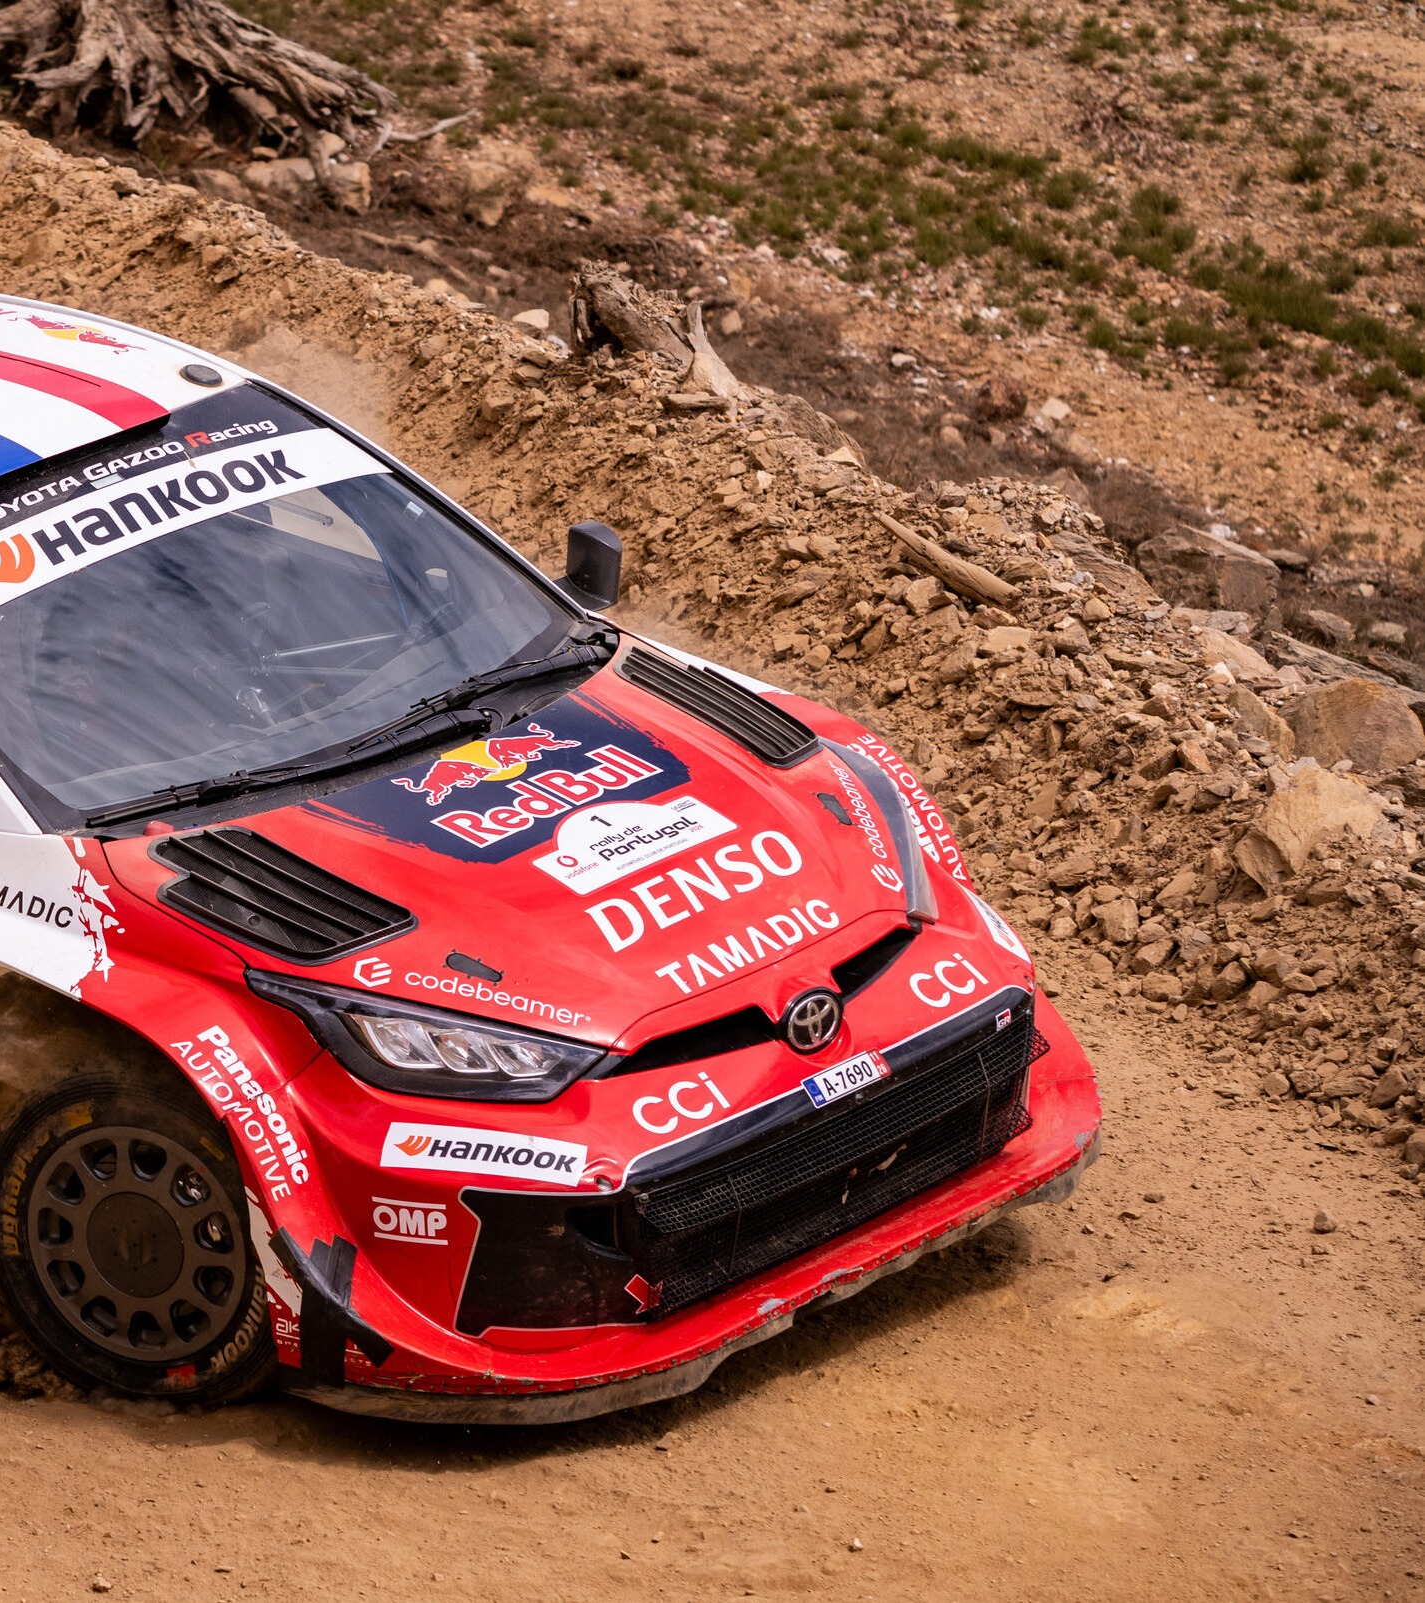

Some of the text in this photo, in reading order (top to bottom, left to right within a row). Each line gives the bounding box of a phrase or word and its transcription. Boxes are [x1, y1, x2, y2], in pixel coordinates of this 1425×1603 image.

[82, 441, 184, 481] GAZOO
[189, 419, 278, 448] Racing
[590, 815, 612, 827] 1
[832, 764, 888, 860] codebeamer
[857, 733, 967, 881] AUTOMOTIVE
[589, 824, 643, 851] rally de
[689, 824, 704, 833] 2026
[564, 861, 600, 879] vodafone
[583, 829, 804, 953] DENSO
[656, 898, 841, 995] TAMADIC
[404, 969, 585, 1028] codebeamer
[997, 1015, 1012, 1029] GR
[869, 1051, 880, 1063] 11
[877, 1063, 887, 1075] 26
[823, 1059, 873, 1097] A-7690
[170, 1040, 291, 1202] AUTOMOTIVE
[197, 1024, 310, 1186] Panasonic
[373, 1203, 448, 1238] OMP
